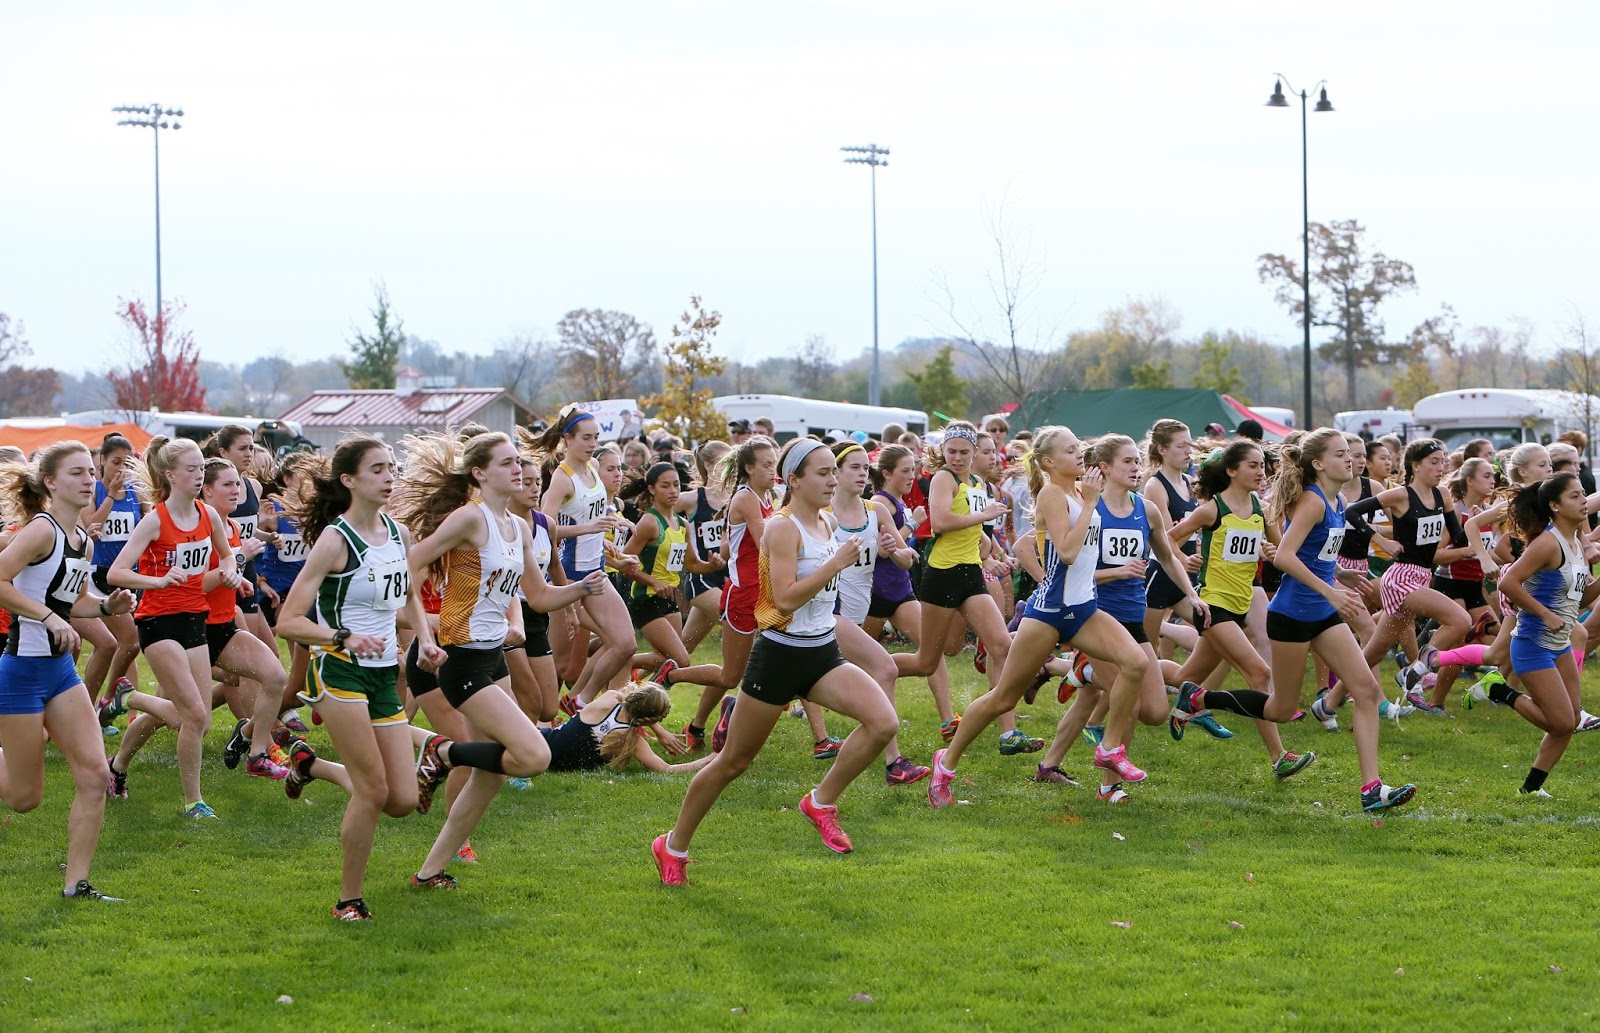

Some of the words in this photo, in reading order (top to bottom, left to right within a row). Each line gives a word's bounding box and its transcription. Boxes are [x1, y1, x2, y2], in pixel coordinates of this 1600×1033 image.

[589, 498, 605, 520] 705
[106, 519, 130, 536] 381
[240, 522, 254, 540] 29
[708, 525, 722, 542] 39
[1422, 521, 1442, 539] 319
[1109, 536, 1139, 558] 382
[1229, 536, 1257, 556] 801
[182, 546, 209, 571] 307
[383, 570, 408, 601] 781
